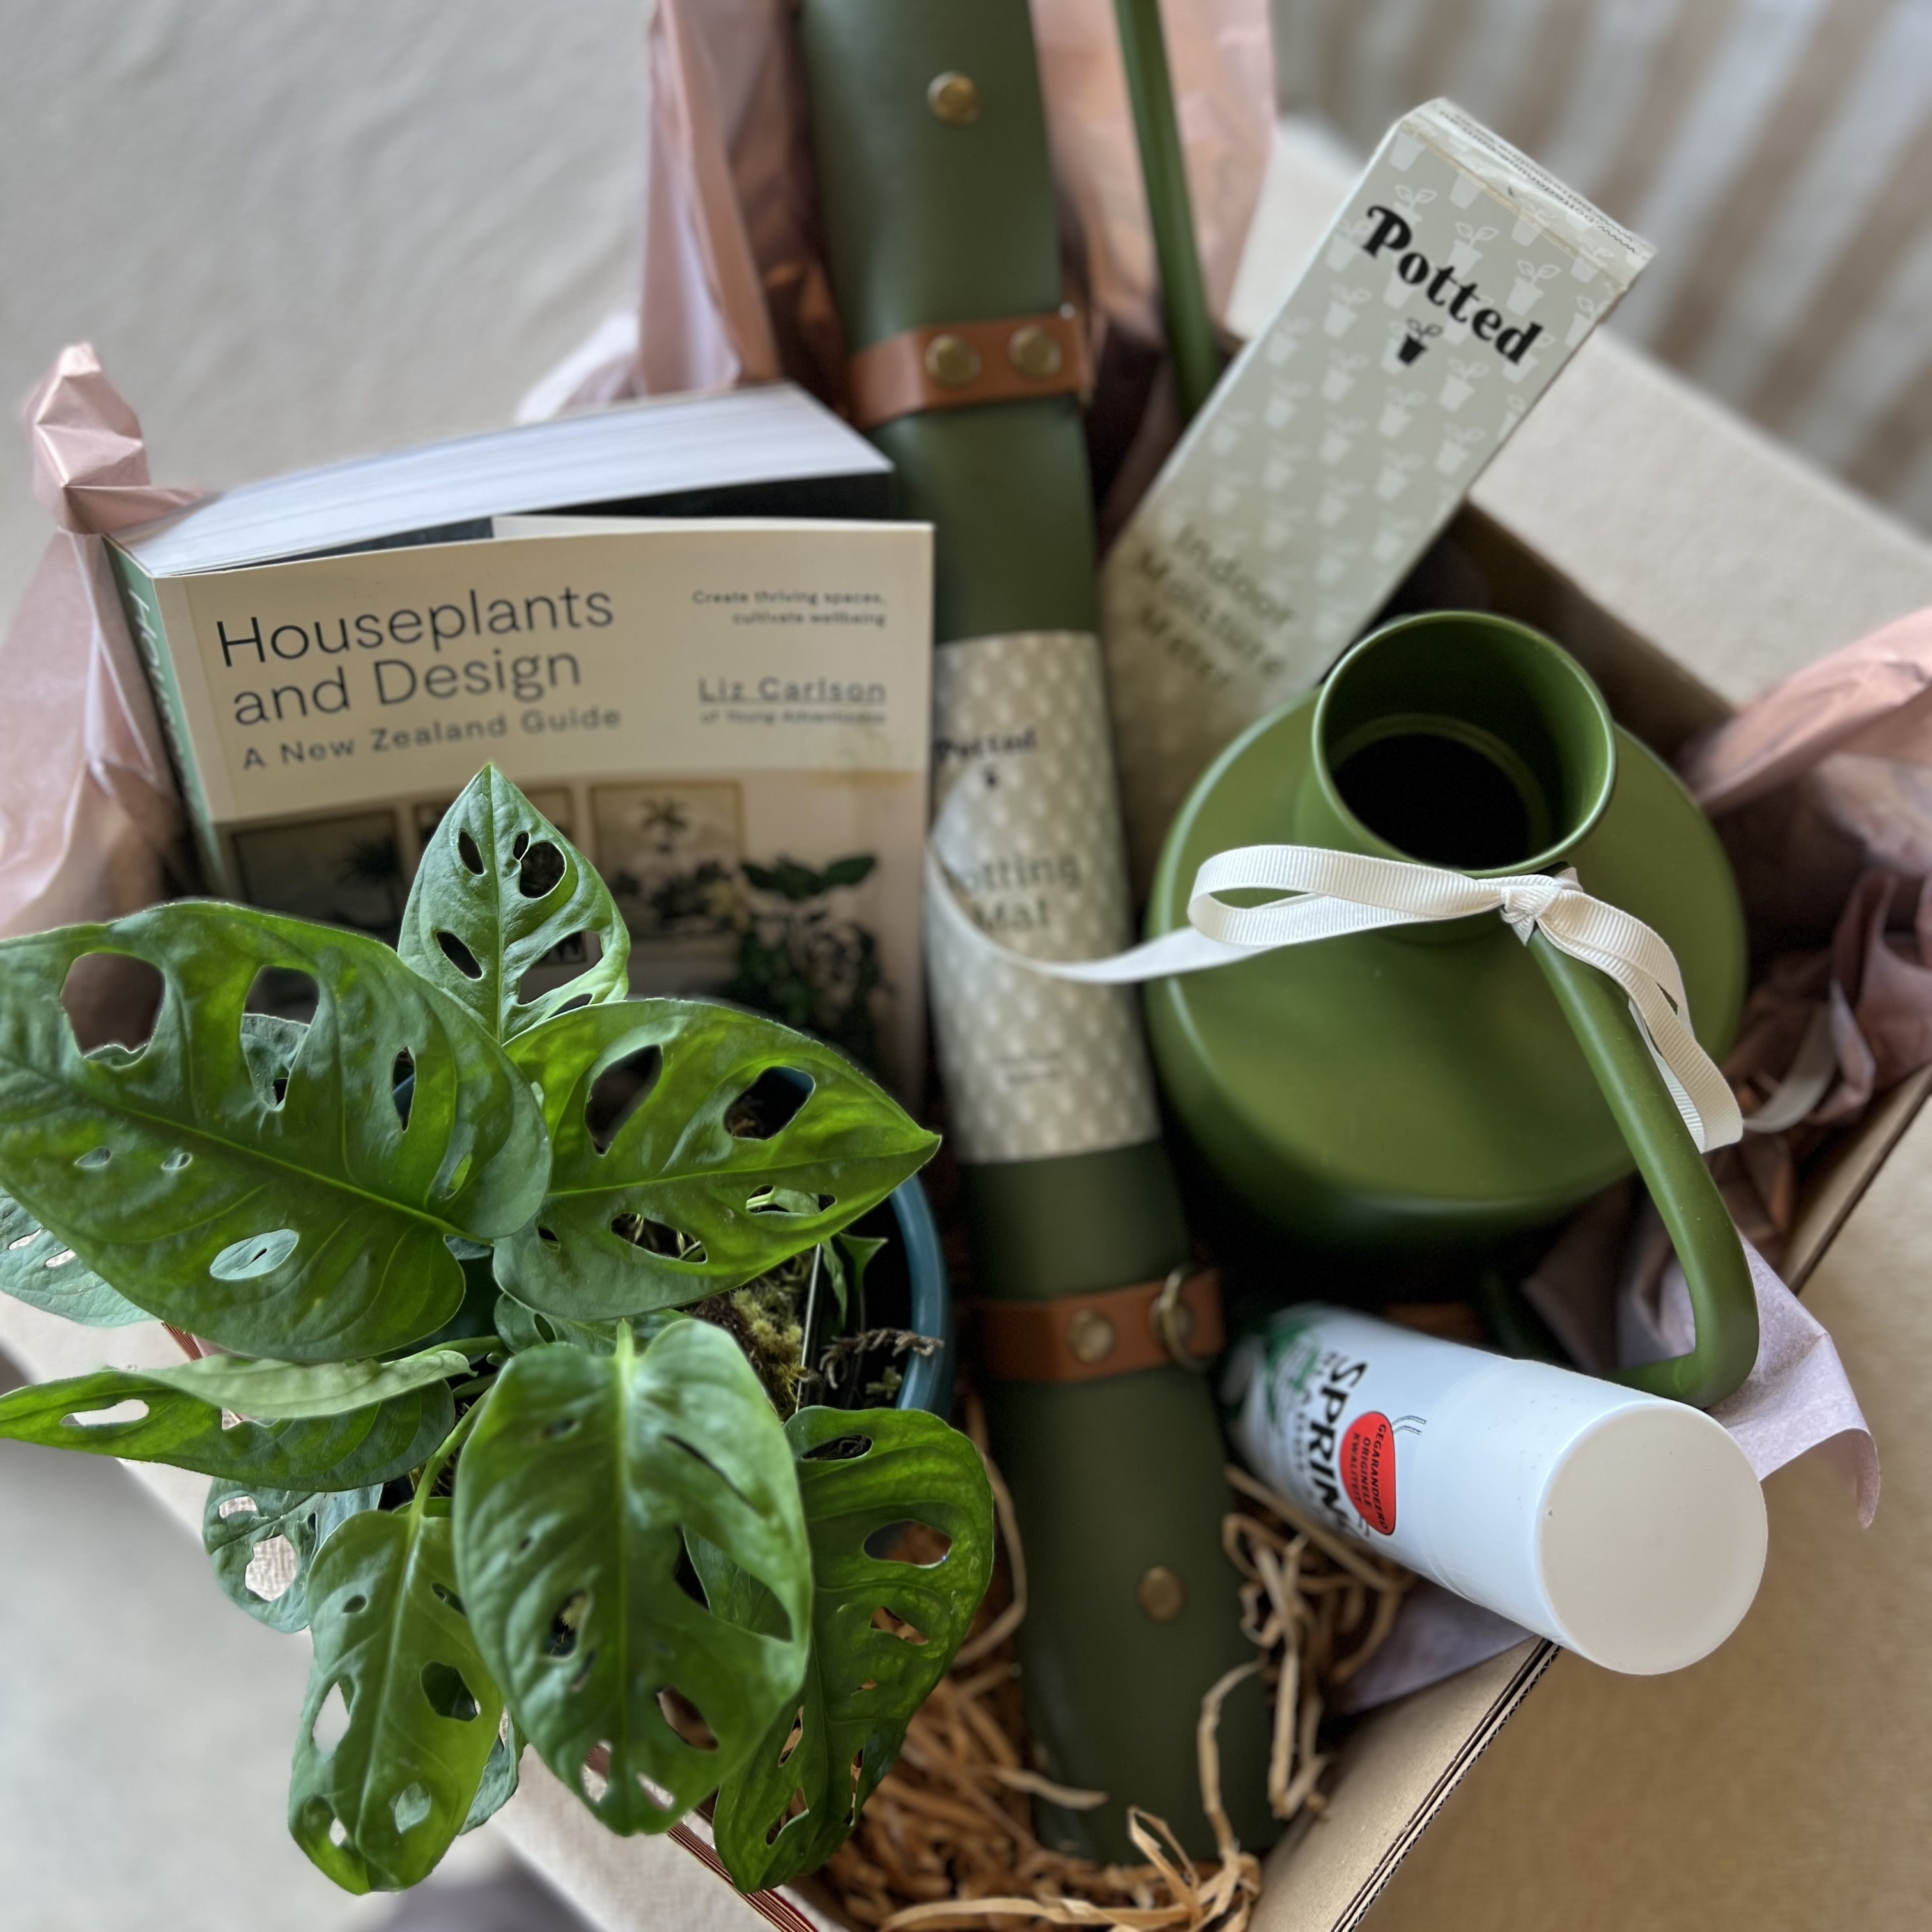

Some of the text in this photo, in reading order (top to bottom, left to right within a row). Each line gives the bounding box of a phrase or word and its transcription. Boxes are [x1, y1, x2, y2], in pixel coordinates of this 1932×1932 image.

[1361, 205, 1543, 366] Potted
[217, 587, 613, 667] Houseplants
[692, 589, 749, 605] Create
[754, 589, 817, 605] thriving
[732, 612, 886, 628] cultivate wellbeing
[234, 649, 580, 725] and Design
[697, 674, 887, 703] Liz Carlson
[243, 705, 621, 770] A New Zealand Guide
[1359, 1436, 1373, 1508] ORIGINELE
[1370, 1423, 1388, 1530] GEGARANDEERD
